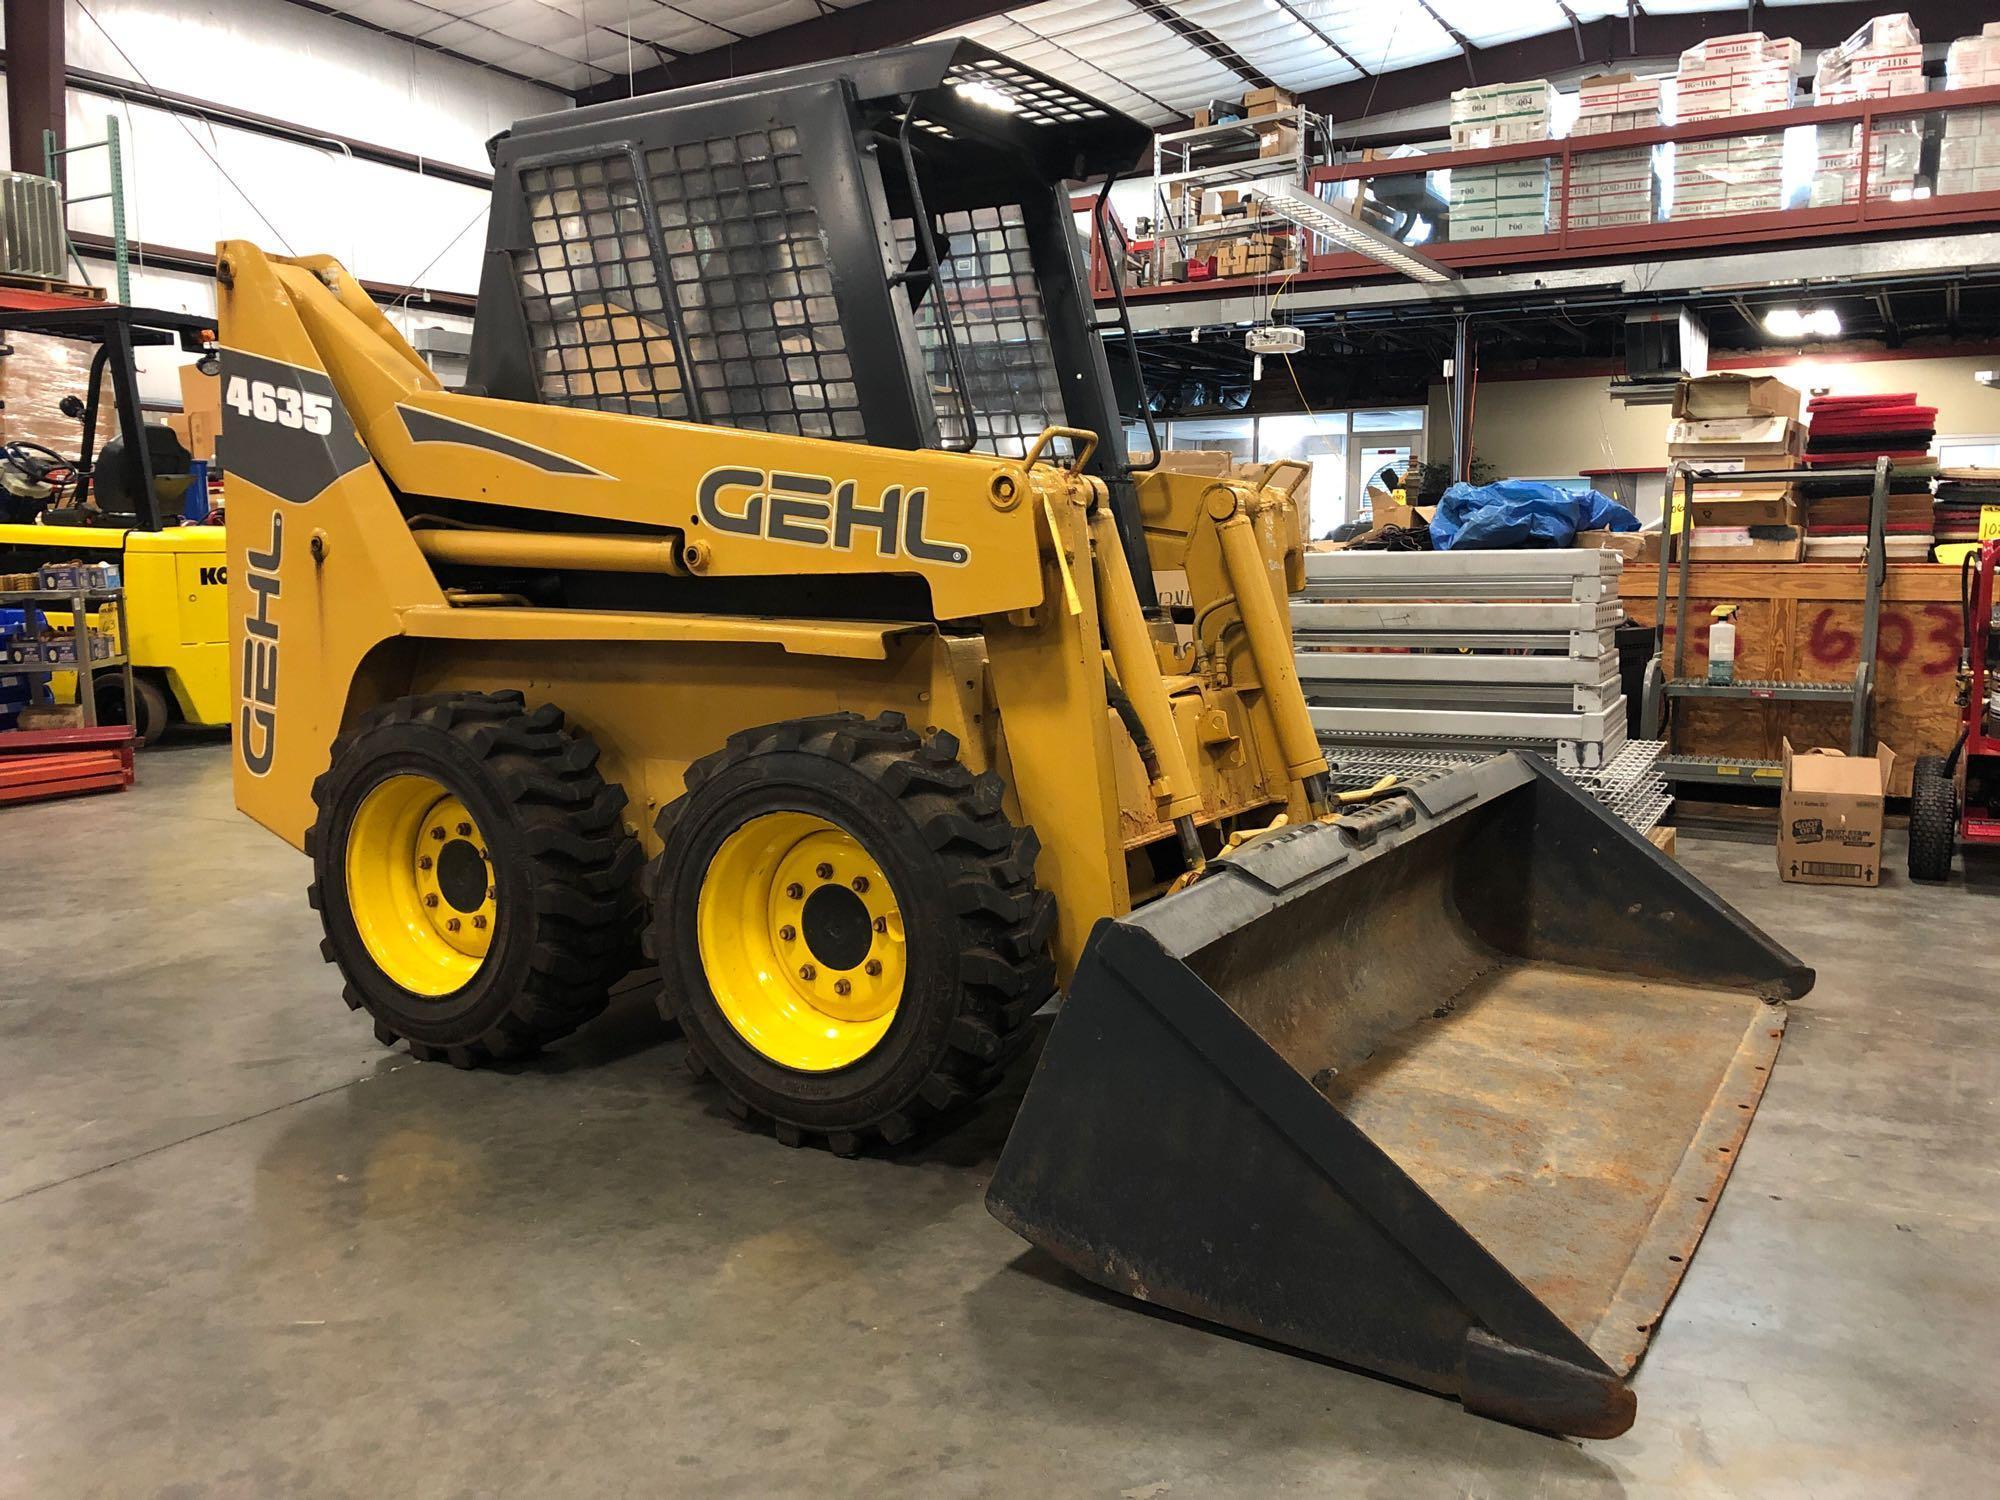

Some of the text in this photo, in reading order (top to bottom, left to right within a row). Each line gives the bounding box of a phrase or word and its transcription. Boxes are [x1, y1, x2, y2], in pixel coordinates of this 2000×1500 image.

[1472, 104, 1486, 113] 004
[1518, 181, 1533, 189] 004
[1470, 225, 1484, 233] 004
[226, 375, 334, 436] 4635
[697, 465, 971, 567] GEHL
[1984, 523, 2000, 538] 10
[241, 509, 284, 777] GEHL
[1809, 602, 1963, 675] 603
[1794, 820, 1820, 829] GOOF
